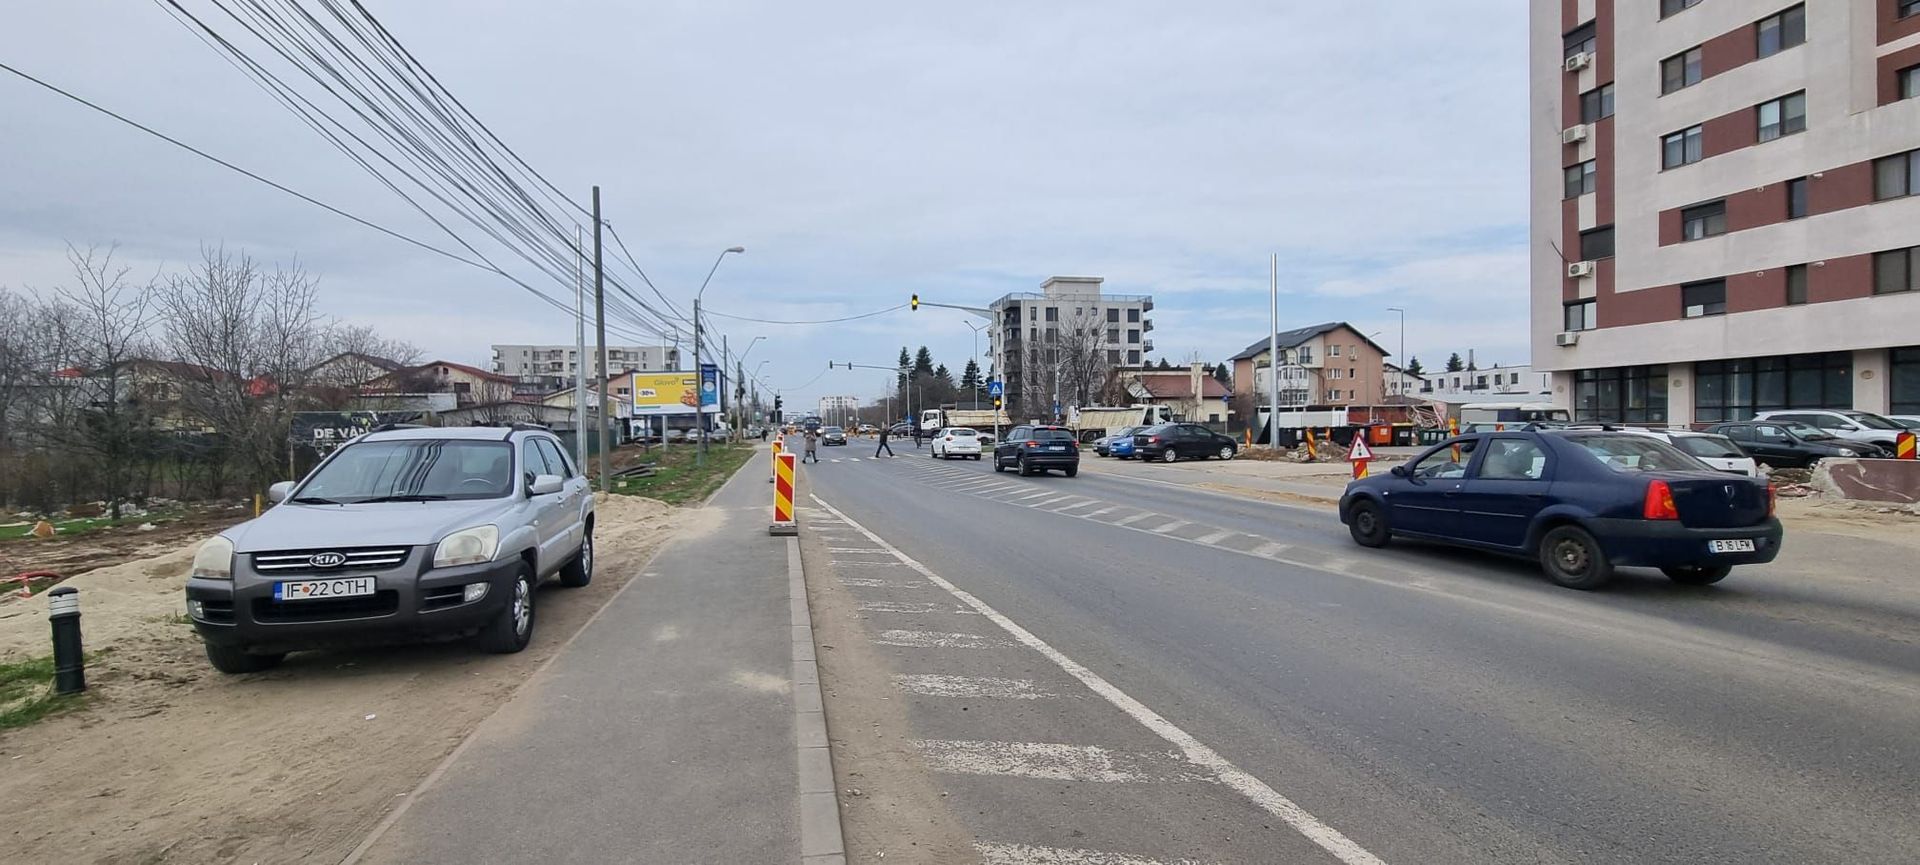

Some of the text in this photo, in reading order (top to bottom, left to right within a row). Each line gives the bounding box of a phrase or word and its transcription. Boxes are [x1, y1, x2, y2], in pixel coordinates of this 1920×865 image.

[313, 428, 335, 439] DE
[1716, 540, 1723, 551] B
[315, 555, 339, 564] KIA
[287, 579, 367, 598] IF 22 CTH
